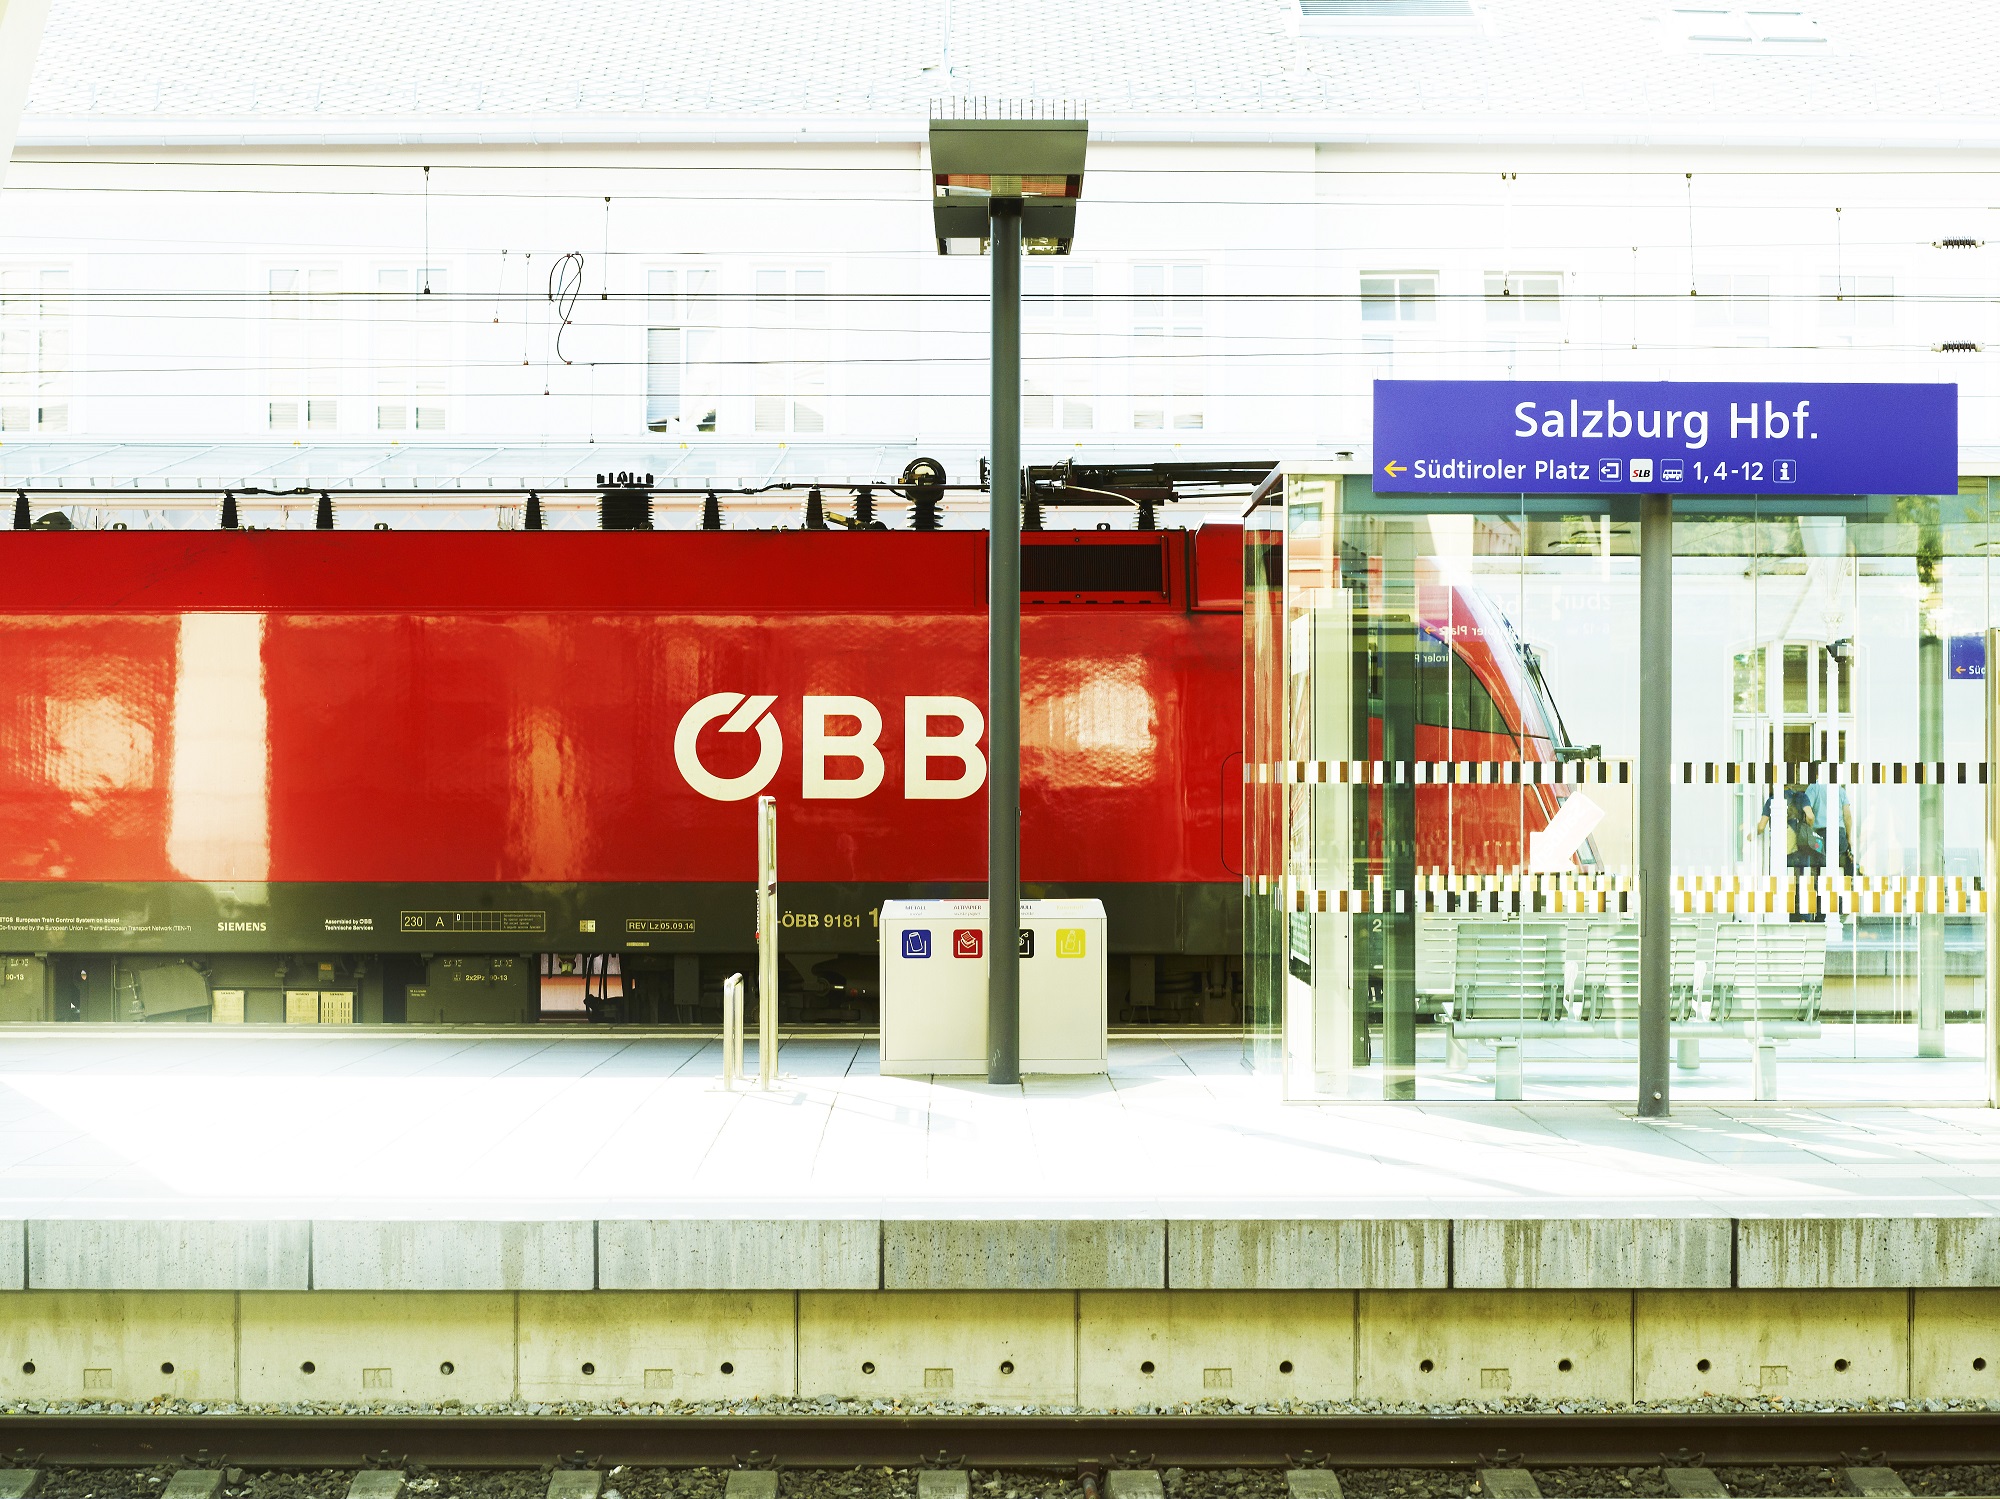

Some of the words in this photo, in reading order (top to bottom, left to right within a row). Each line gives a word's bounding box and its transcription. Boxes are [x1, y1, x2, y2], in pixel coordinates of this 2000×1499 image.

[1514, 399, 1709, 450] Salzburg
[1730, 400, 1818, 440] Hbf.
[1414, 458, 1527, 480] Südtiroler
[1536, 459, 1590, 480] Platz
[1632, 469, 1651, 478] SLB
[673, 691, 988, 802] ÖBB
[217, 921, 267, 932] SIEMENS
[404, 916, 423, 927] 230
[435, 916, 445, 927] A
[628, 922, 647, 930] REV
[649, 922, 659, 930] Lz
[660, 922, 694, 930] 05.09.14
[823, 914, 860, 928] 9181
